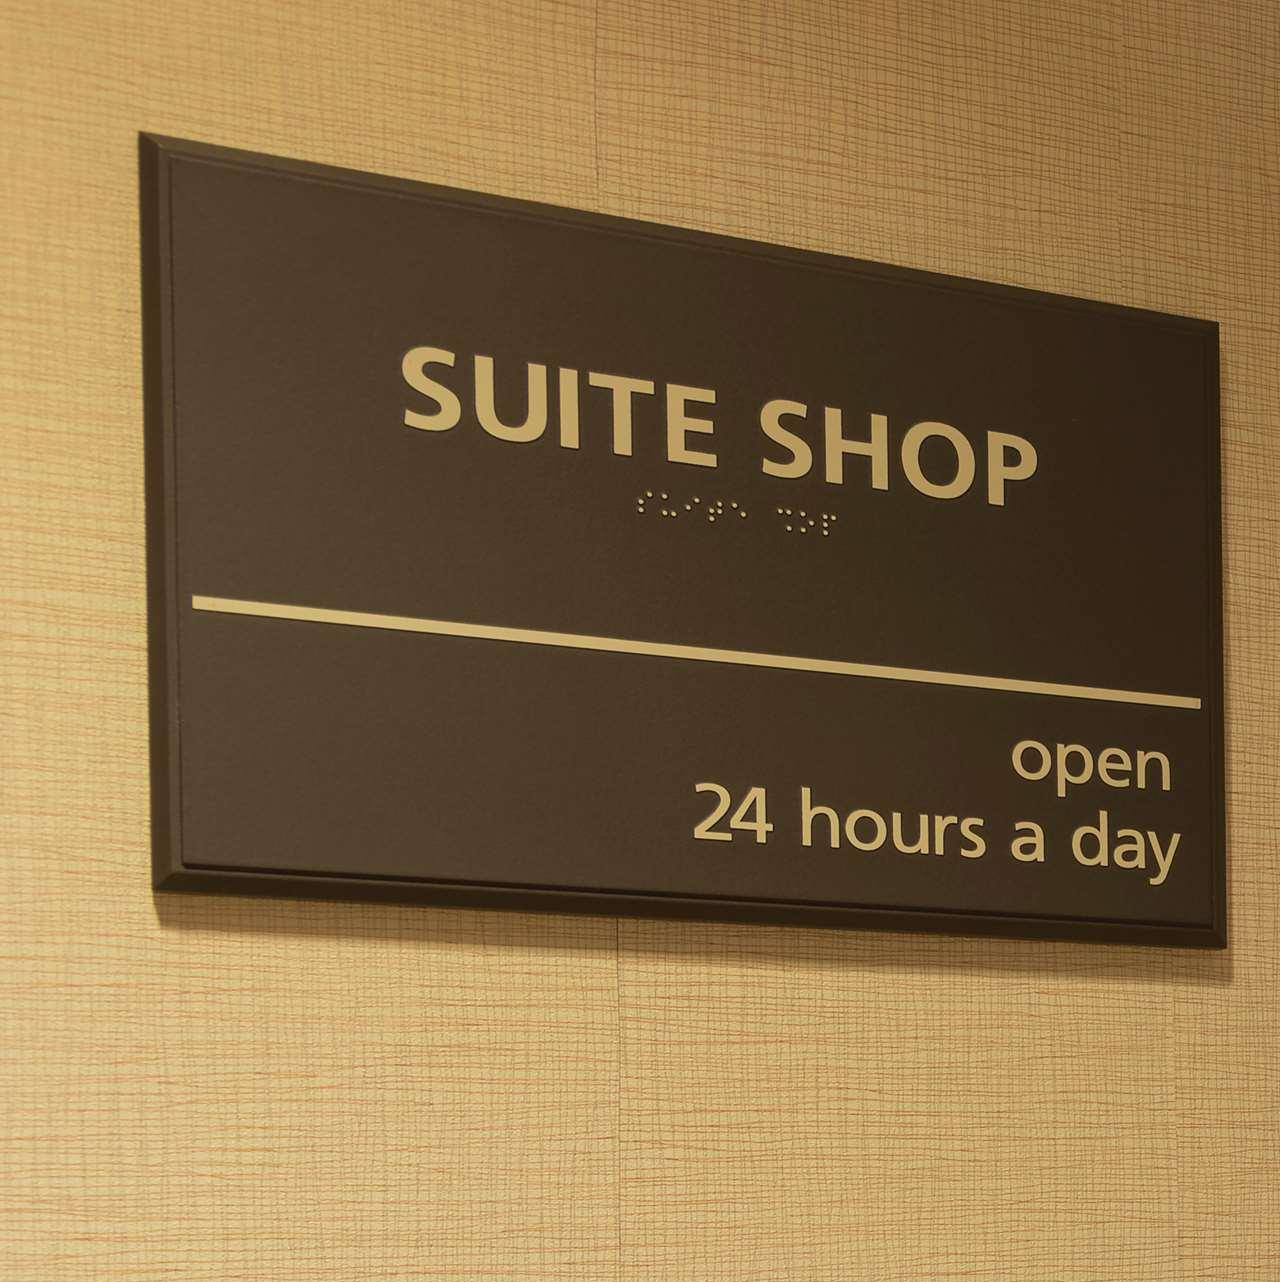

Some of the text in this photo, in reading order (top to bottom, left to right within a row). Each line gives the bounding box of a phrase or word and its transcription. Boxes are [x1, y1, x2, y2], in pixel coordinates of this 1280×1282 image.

[401, 346, 1038, 506] SUITE SHOP
[1011, 740, 1171, 798] open
[693, 782, 1181, 885] 24 hours a day
